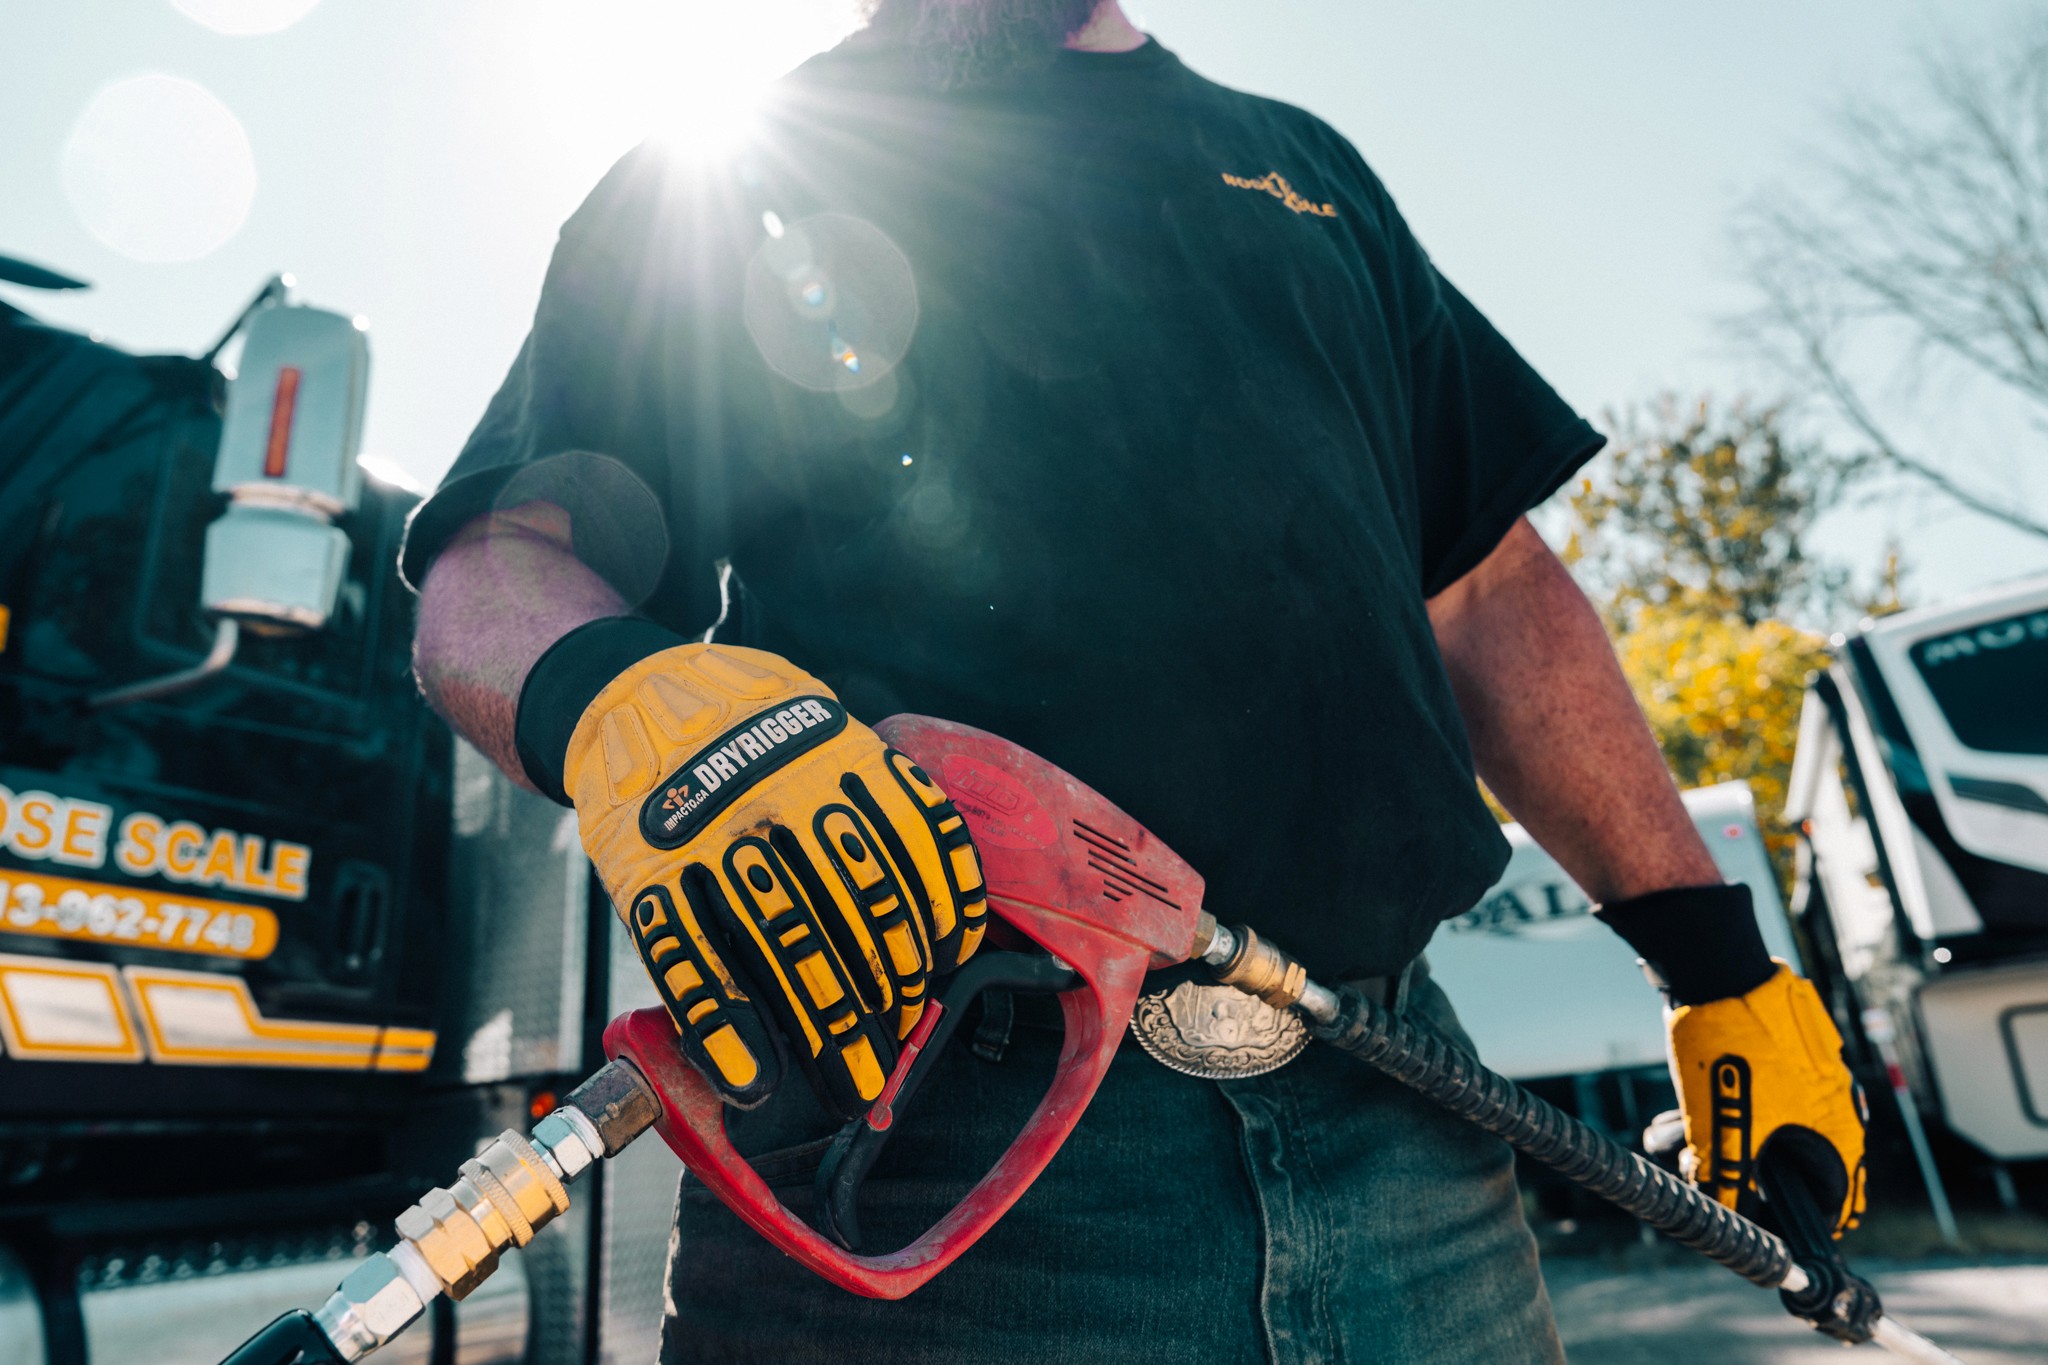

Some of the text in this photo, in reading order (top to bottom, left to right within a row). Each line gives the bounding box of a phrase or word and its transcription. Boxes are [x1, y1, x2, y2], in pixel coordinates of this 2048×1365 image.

[692, 699, 832, 793] DRYRIGGER
[664, 789, 710, 831] IMPACTO.CA
[116, 812, 311, 900] SCALE
